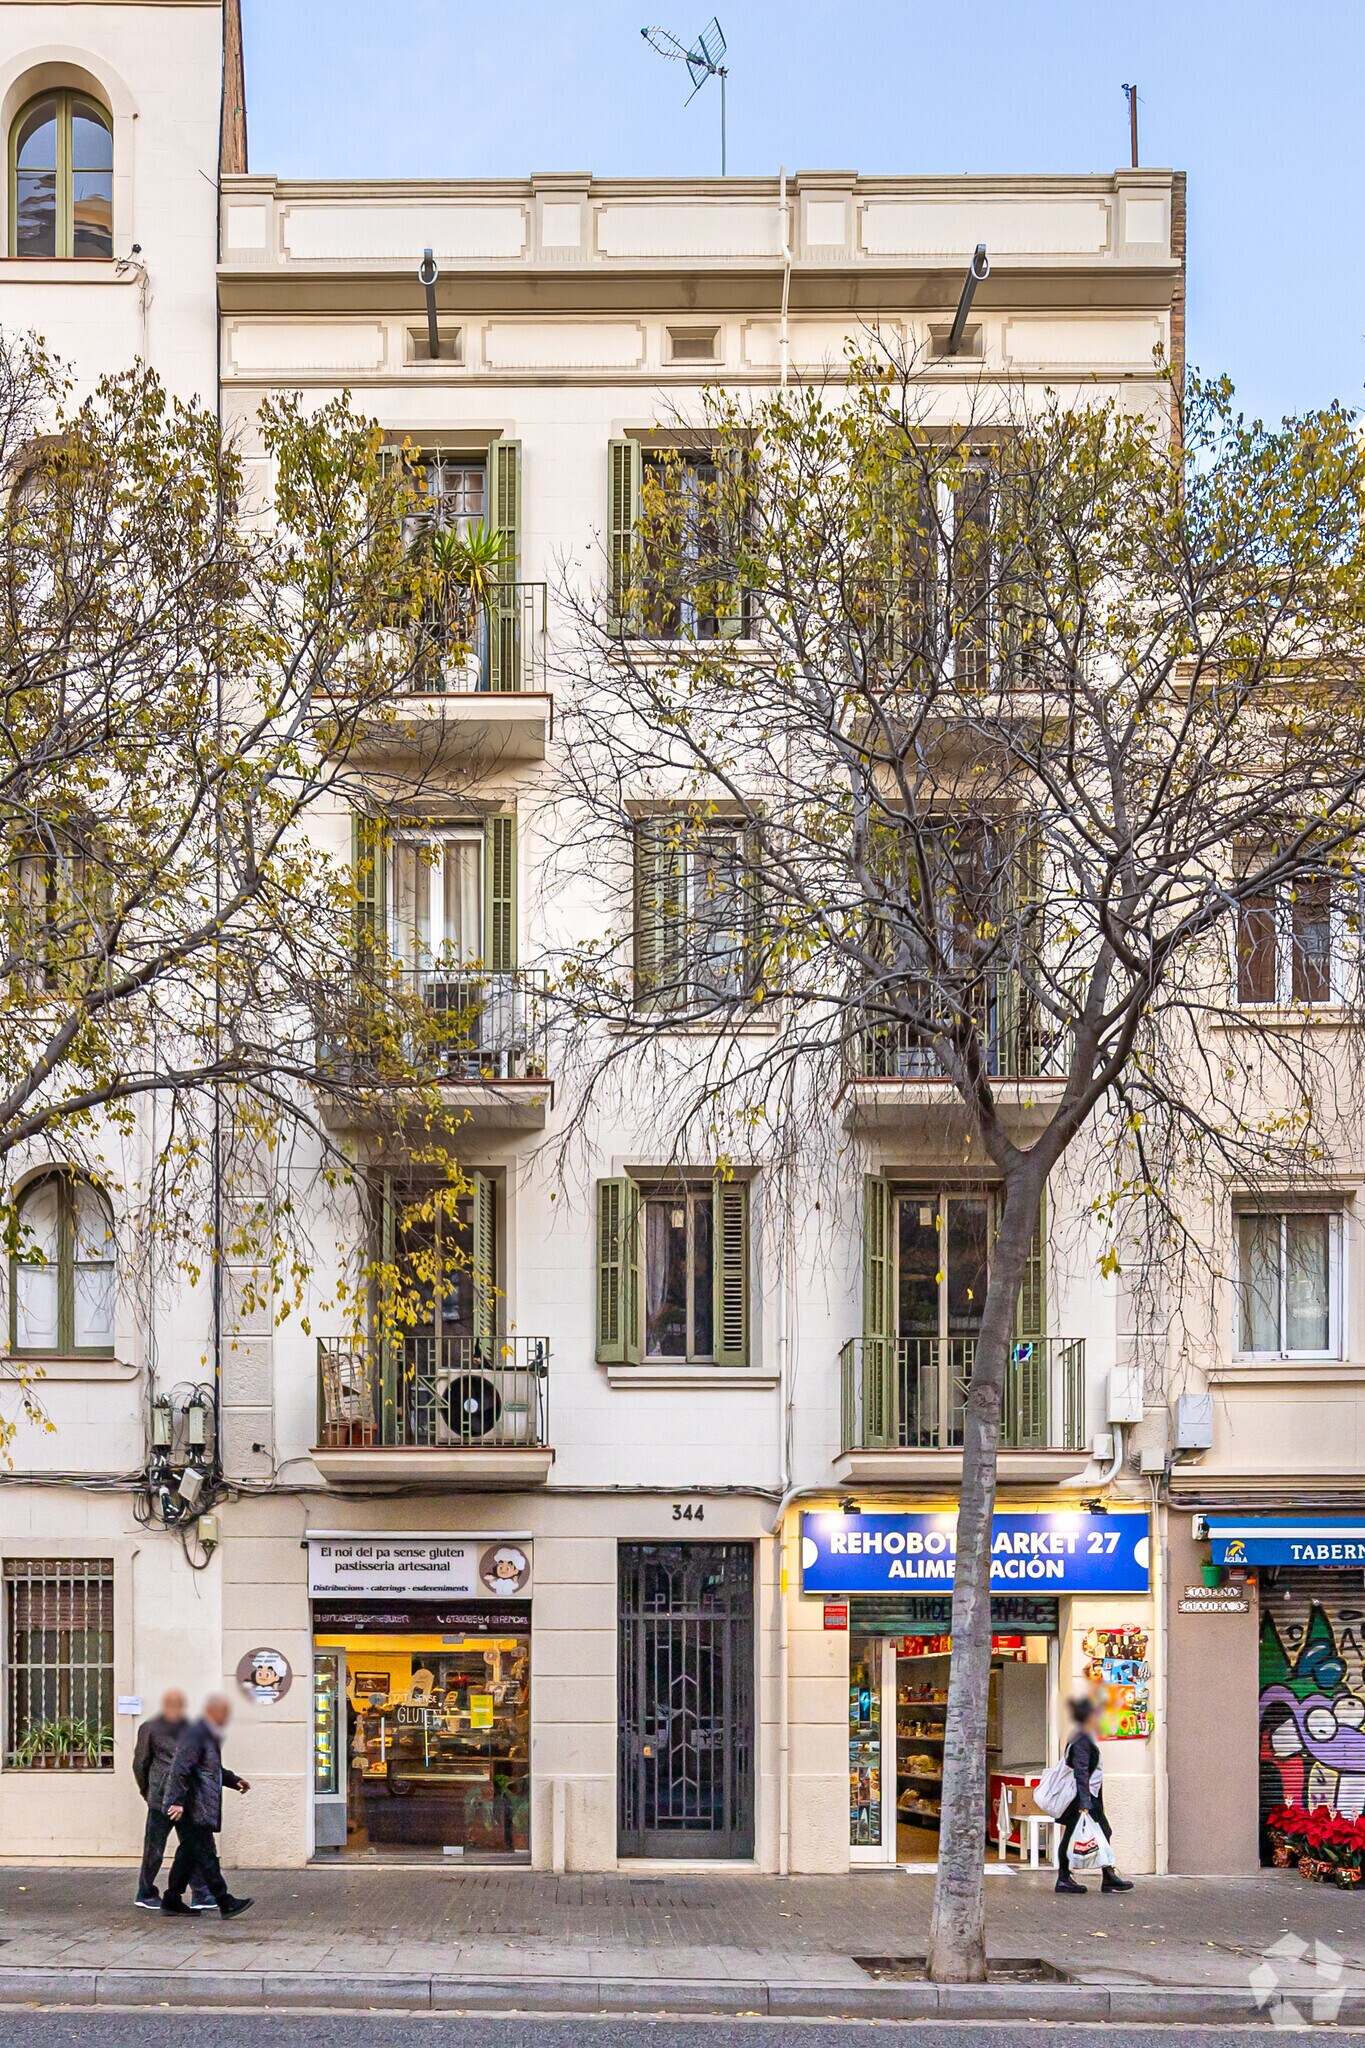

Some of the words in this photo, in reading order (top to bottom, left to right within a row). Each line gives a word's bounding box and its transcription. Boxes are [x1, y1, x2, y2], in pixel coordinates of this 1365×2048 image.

[672, 1504, 704, 1521] 344
[830, 1532, 958, 1554] REHOBOT
[991, 1532, 1079, 1554] ARKET
[1086, 1532, 1121, 1554] 27
[321, 1547, 332, 1557] El
[335, 1547, 353, 1557] noi
[356, 1547, 373, 1557] del
[376, 1549, 390, 1560] pa
[393, 1549, 426, 1557] sense
[429, 1548, 464, 1560] gluten
[335, 1561, 395, 1573] pastisseria
[398, 1562, 450, 1571] artesanal
[888, 1556, 1064, 1579] ALIMEACIÓN
[370, 1585, 406, 1593] caterings
[1192, 1588, 1235, 1596] TABERNA
[1185, 1603, 1229, 1611] GUAJIRA
